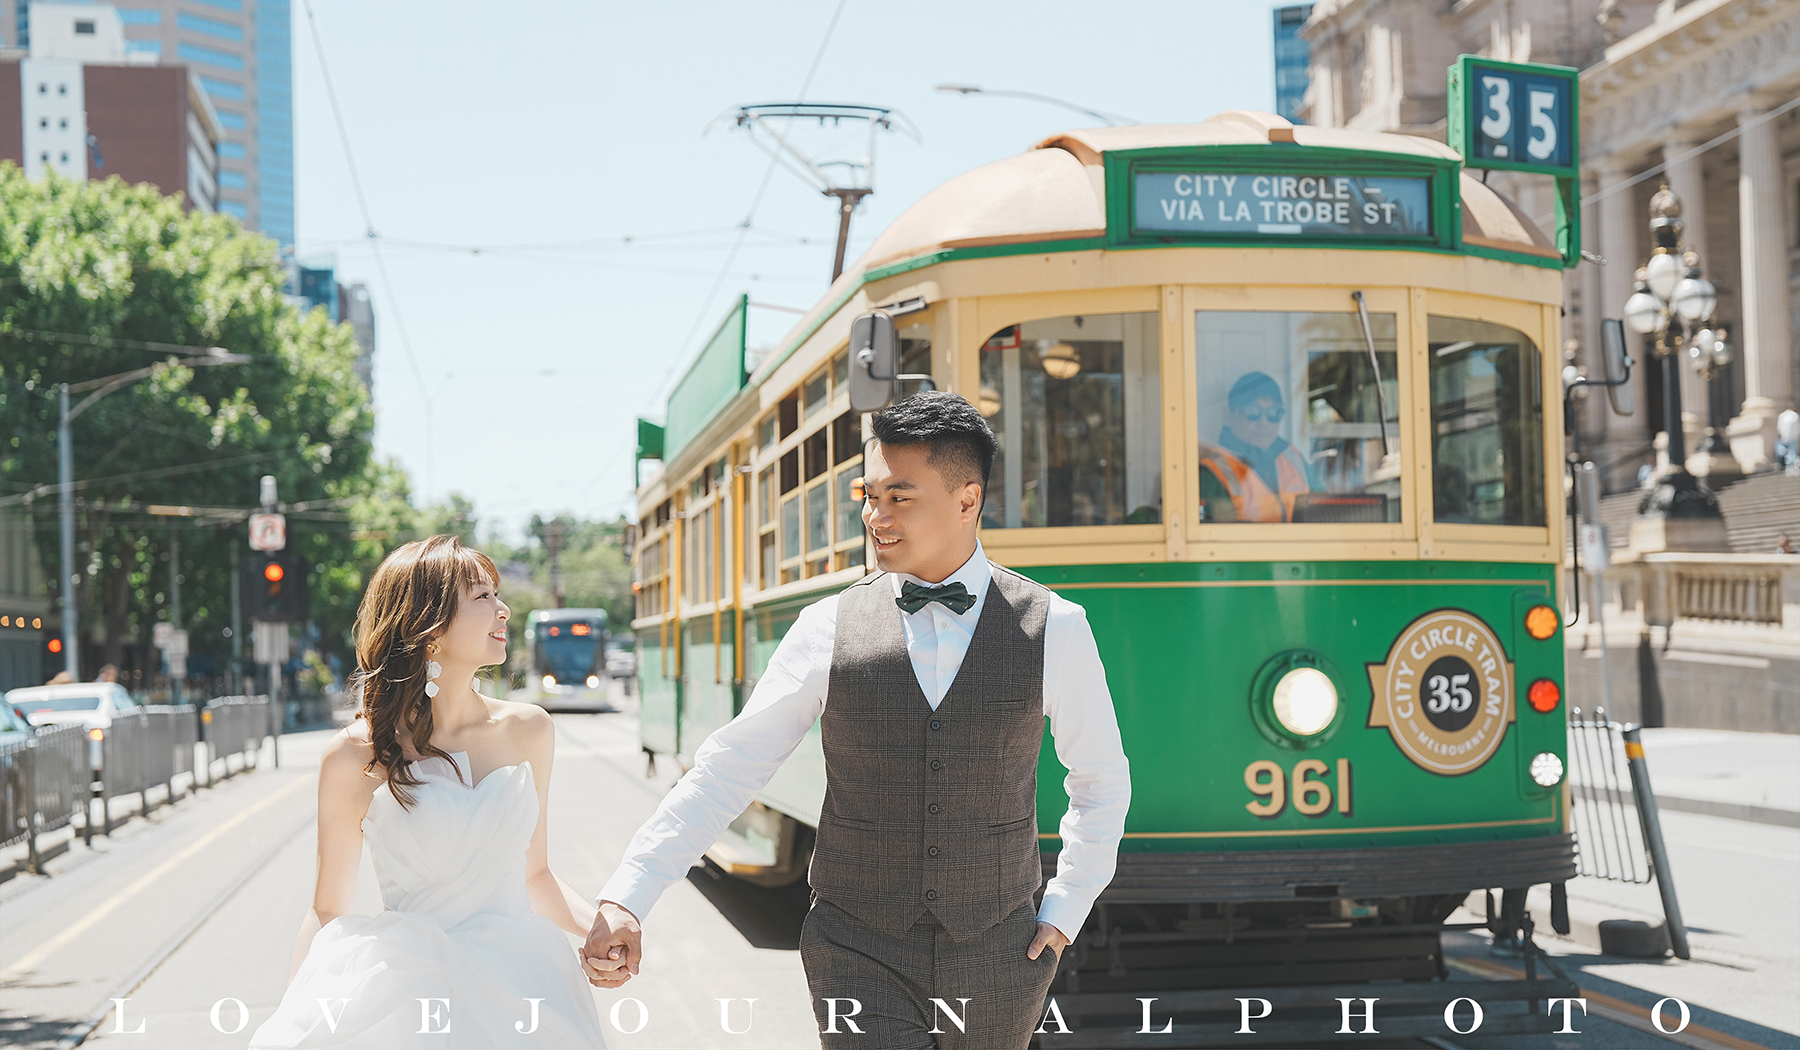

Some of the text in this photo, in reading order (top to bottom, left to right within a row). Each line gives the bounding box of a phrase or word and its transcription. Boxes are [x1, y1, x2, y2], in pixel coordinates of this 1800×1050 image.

[1480, 75, 1558, 160] 35
[1173, 173, 1237, 197] CITY
[1252, 174, 1350, 201] CIRCLE
[1160, 199, 1397, 225] VIA LA TROBE ST
[1396, 626, 1501, 719] CITY CIRCLE TRAM
[1427, 673, 1473, 713] 35
[1417, 730, 1486, 756] MELBOURNE
[1243, 757, 1353, 818] 961
